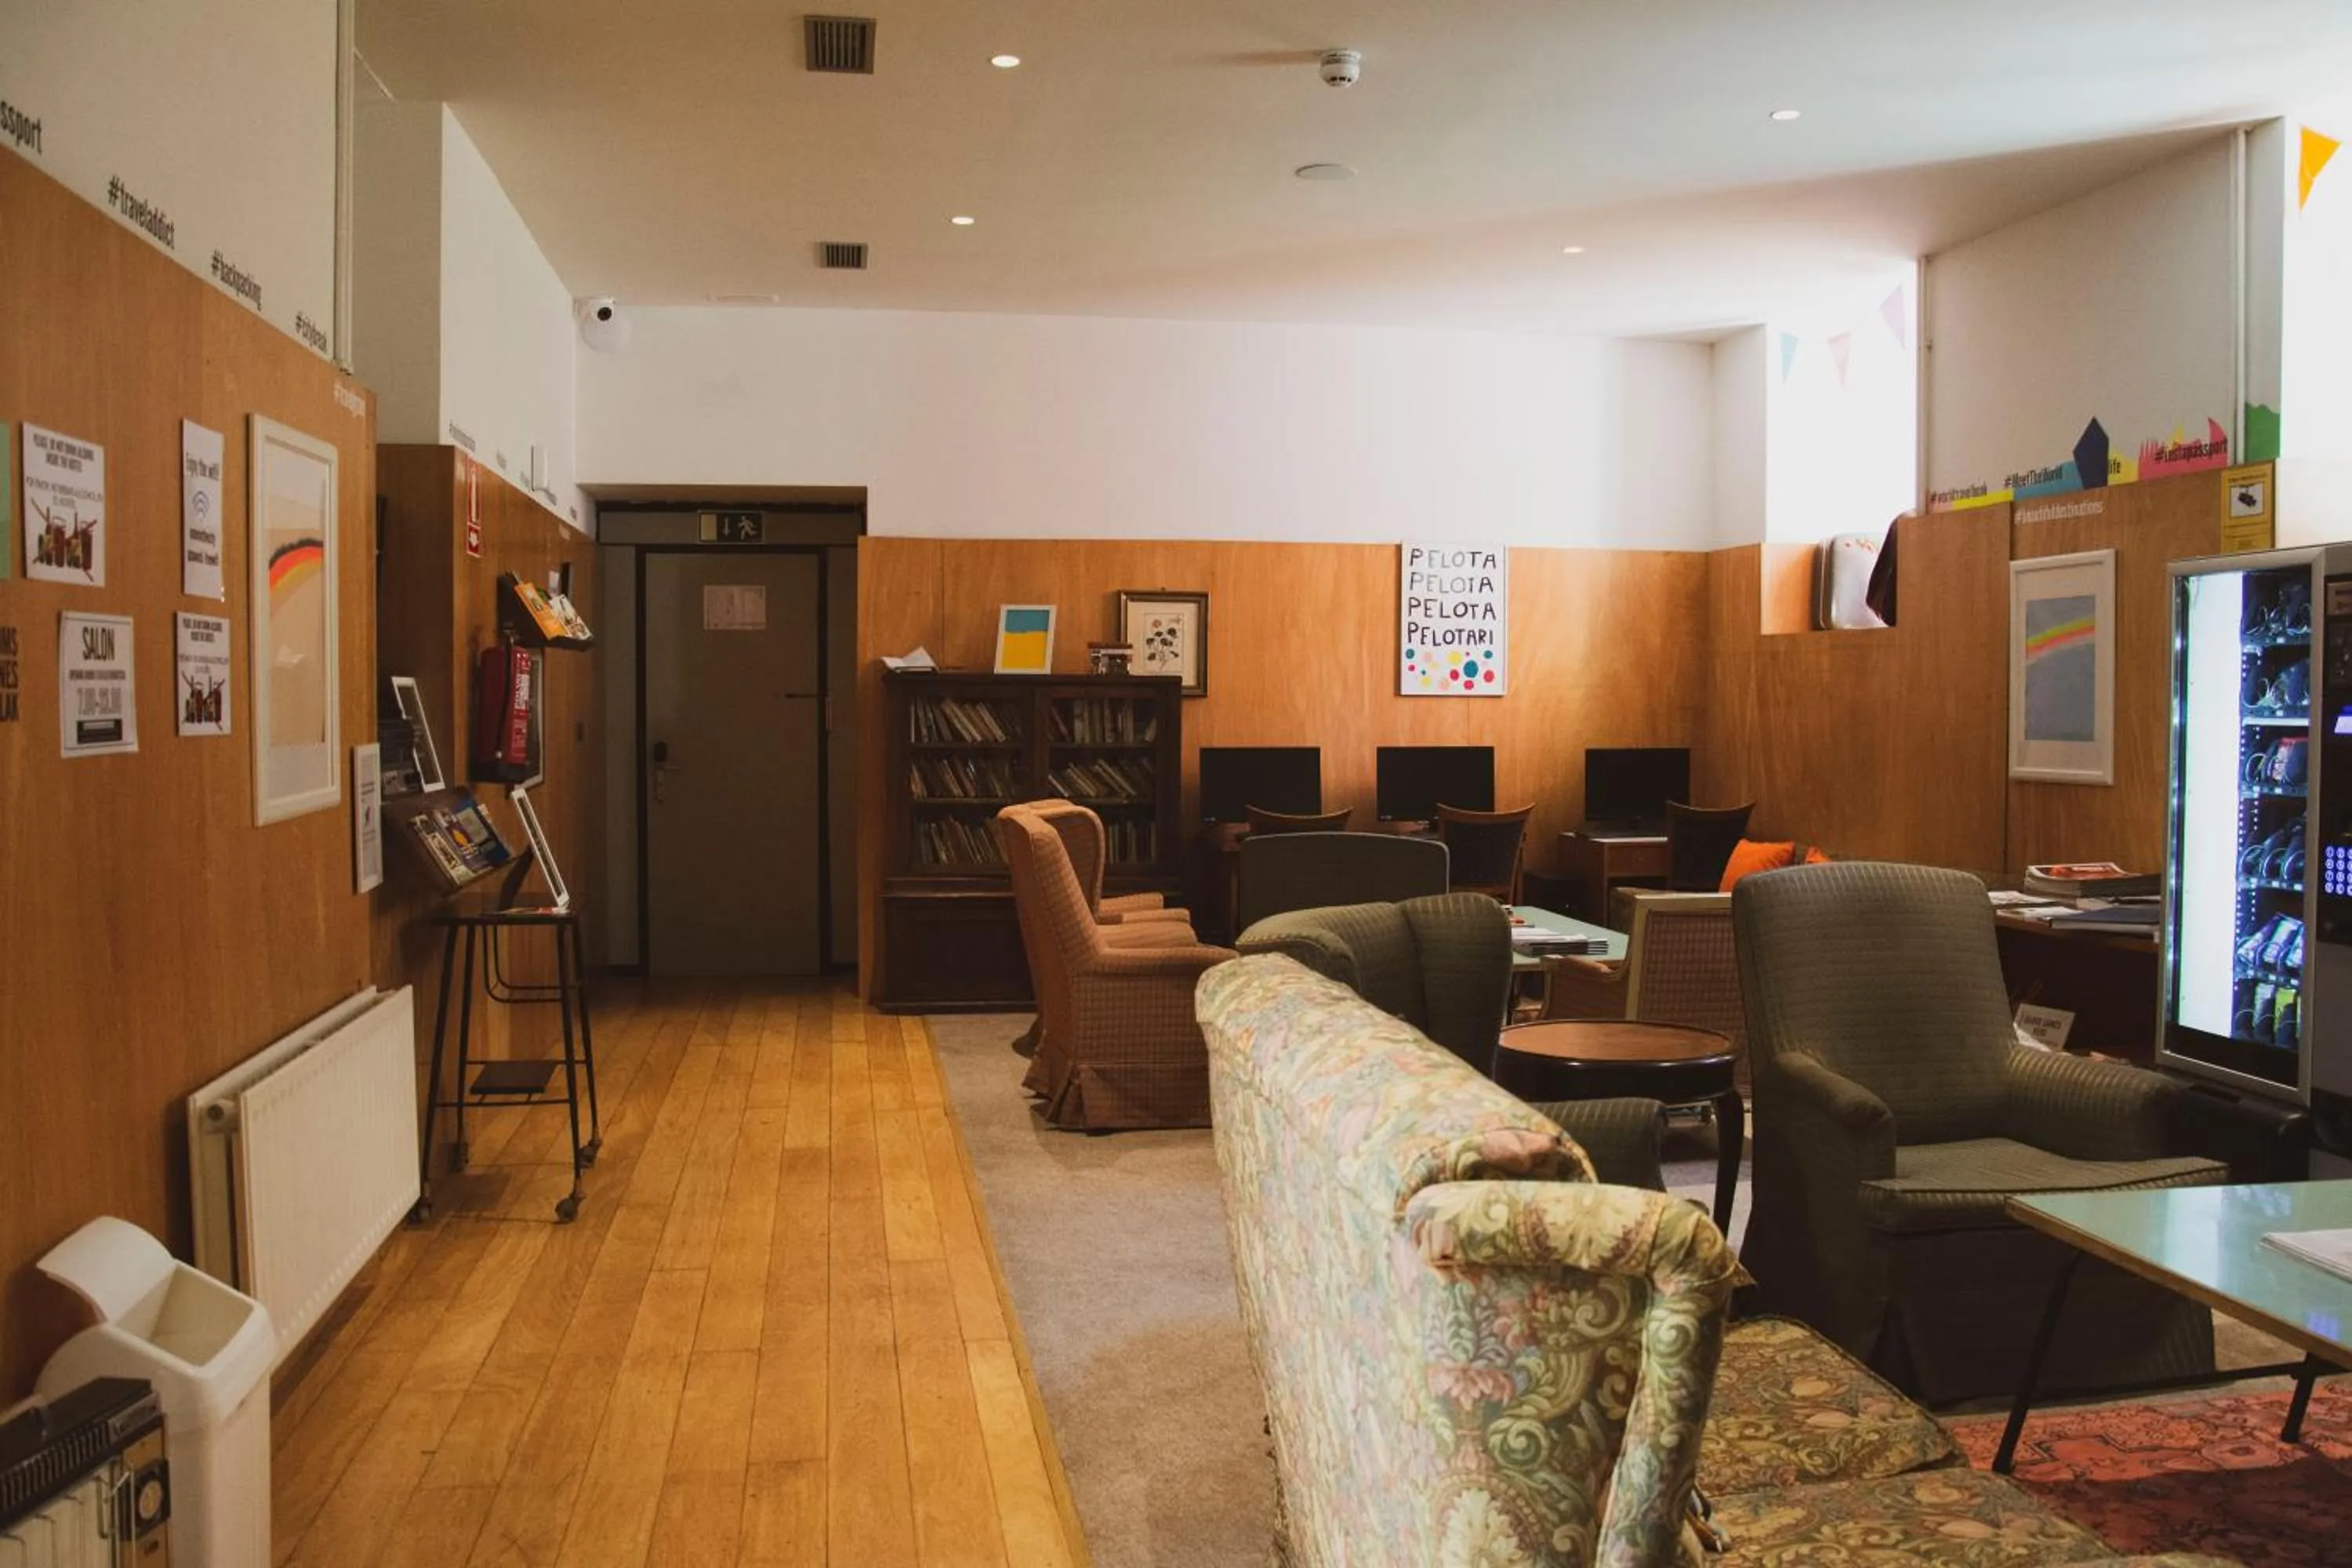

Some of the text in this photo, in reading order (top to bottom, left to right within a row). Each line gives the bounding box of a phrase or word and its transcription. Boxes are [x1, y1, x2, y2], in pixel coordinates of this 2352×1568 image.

[107, 174, 175, 249] #traveladdict
[2154, 436, 2227, 464] #instapassport
[1410, 548, 1496, 568] PELOTA
[1410, 572, 1494, 593] PELOTA
[1408, 597, 1496, 620] PELOTA
[82, 626, 114, 660] SALON
[1407, 622, 1494, 646] PELOTARI
